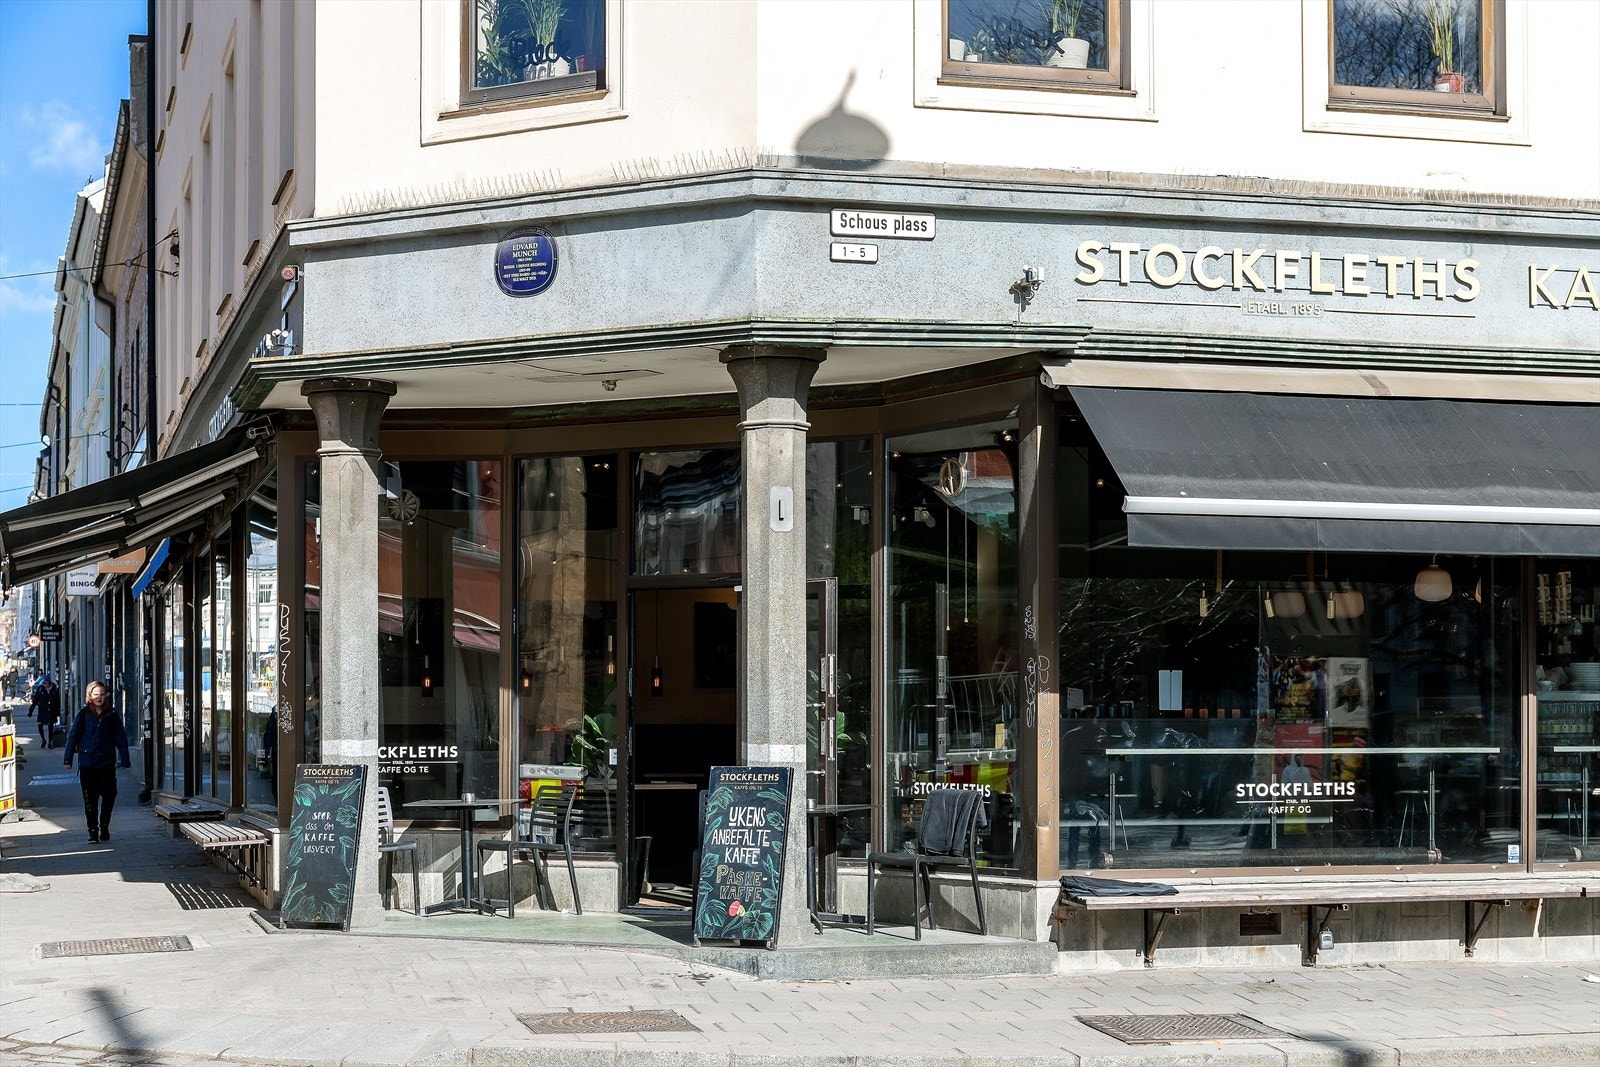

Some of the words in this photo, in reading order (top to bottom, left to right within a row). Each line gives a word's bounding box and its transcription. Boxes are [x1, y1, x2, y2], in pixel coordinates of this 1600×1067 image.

[840, 213, 888, 230] Schous
[894, 216, 928, 234] plass
[512, 250, 538, 258] MUNCH
[1075, 240, 1481, 302] STOCKFLETHS
[1247, 302, 1287, 315] ETABL.
[1292, 303, 1321, 315] 1895
[303, 768, 354, 776] STOCKFLETHS
[720, 773, 779, 781] STOCKFLETHS
[1236, 782, 1355, 797] STOCKFLETHS
[728, 806, 767, 827] UKENS
[304, 833, 335, 842] KAFFE
[711, 829, 771, 847] ANBEFALTE
[303, 845, 336, 854] LØSVEKT
[724, 847, 761, 865] KAFFE
[719, 886, 762, 902] KAFFE
